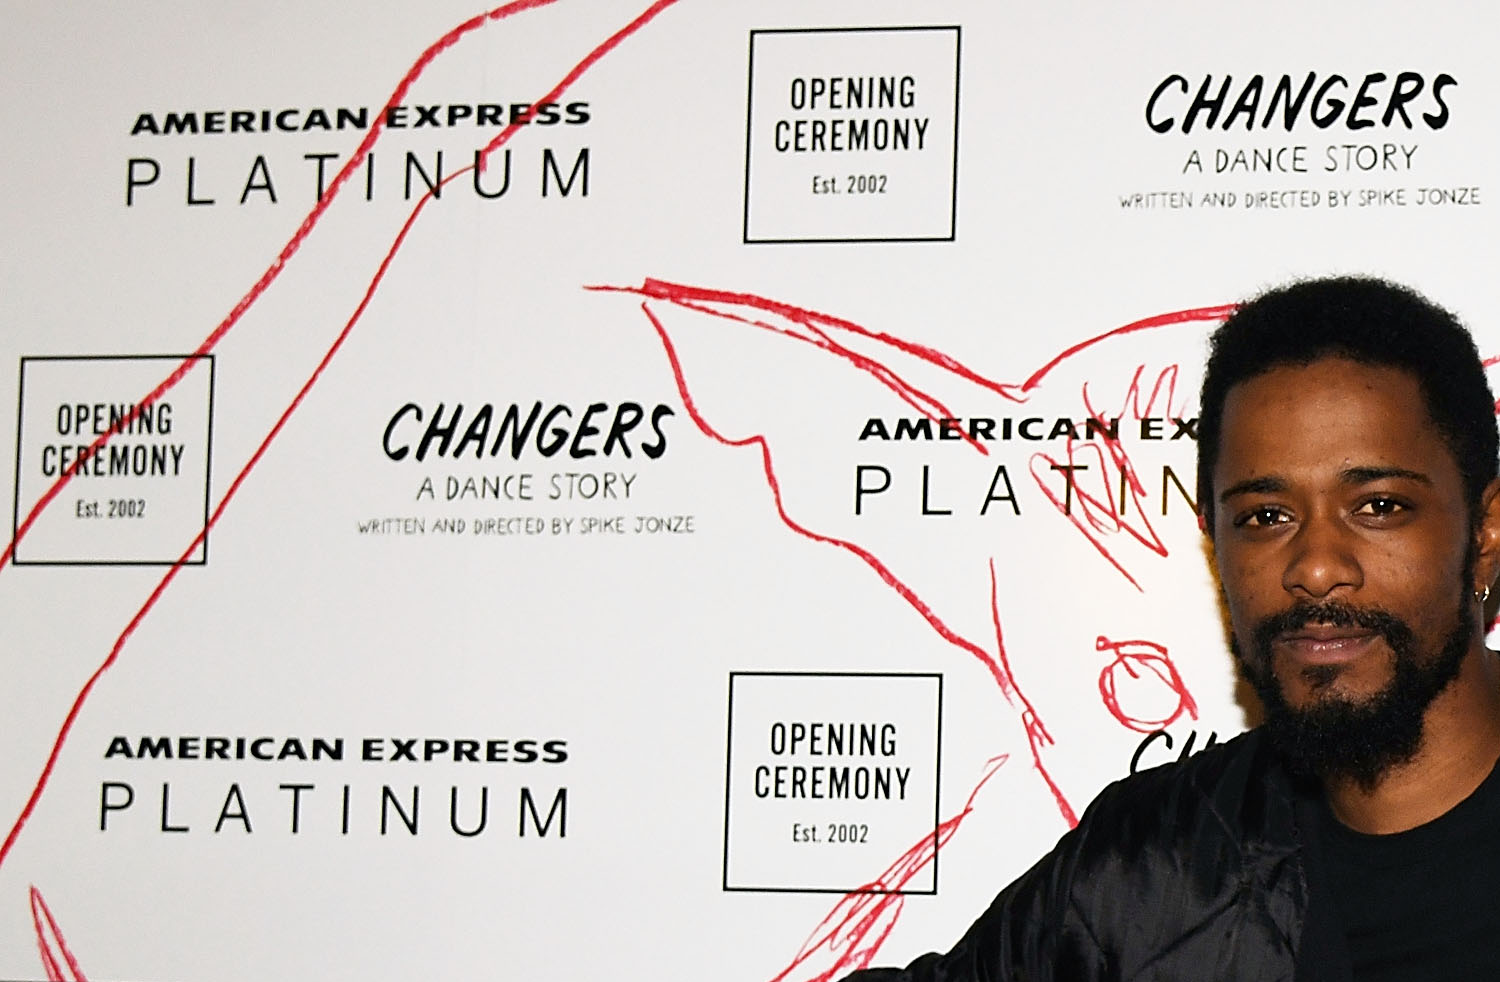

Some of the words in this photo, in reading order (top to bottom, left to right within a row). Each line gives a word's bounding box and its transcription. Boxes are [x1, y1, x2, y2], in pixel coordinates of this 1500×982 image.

[791, 76, 914, 110] OPENING
[1146, 71, 1457, 134] CHANGERS
[131, 108, 367, 135] AMERICAN
[386, 102, 590, 128] EXPRESS
[776, 118, 928, 152] CEREMONY
[1184, 151, 1202, 172] A
[1216, 147, 1307, 173] DANCE
[1325, 144, 1417, 171] STORY
[127, 148, 589, 206] PLATINUM
[813, 175, 841, 194] Est.
[848, 174, 887, 194] 2002
[1121, 192, 1192, 208] WRITTEN
[1201, 192, 1236, 208] AND
[1245, 190, 1320, 208] DIRECTED
[1328, 190, 1351, 208] BY
[1359, 189, 1406, 207] SPIKE
[1416, 187, 1480, 205] JONZE
[58, 403, 171, 435] OPENING
[383, 401, 675, 462] CHANGERS
[859, 418, 1119, 440] AMERICAN
[43, 445, 183, 477] CEREMONY
[417, 478, 434, 499] A
[447, 475, 531, 500] DANCE
[550, 473, 635, 499] STORY
[854, 463, 1202, 517] PLATIN
[76, 499, 102, 519] Est.
[108, 499, 145, 519] 2002
[358, 518, 425, 534] WRITTEN
[432, 519, 465, 534] AND
[474, 517, 544, 535] DIRECTED
[552, 518, 573, 535] BY
[581, 517, 624, 534] SPIKE
[635, 516, 694, 533] JONZE
[105, 737, 343, 760] AMERICAN
[362, 739, 567, 763] EXPRESS
[771, 723, 895, 756] OPENING
[755, 766, 910, 800] CEREMONY
[101, 782, 567, 837] PLATINUM
[793, 823, 821, 843] Est.
[828, 824, 868, 843] 2002
